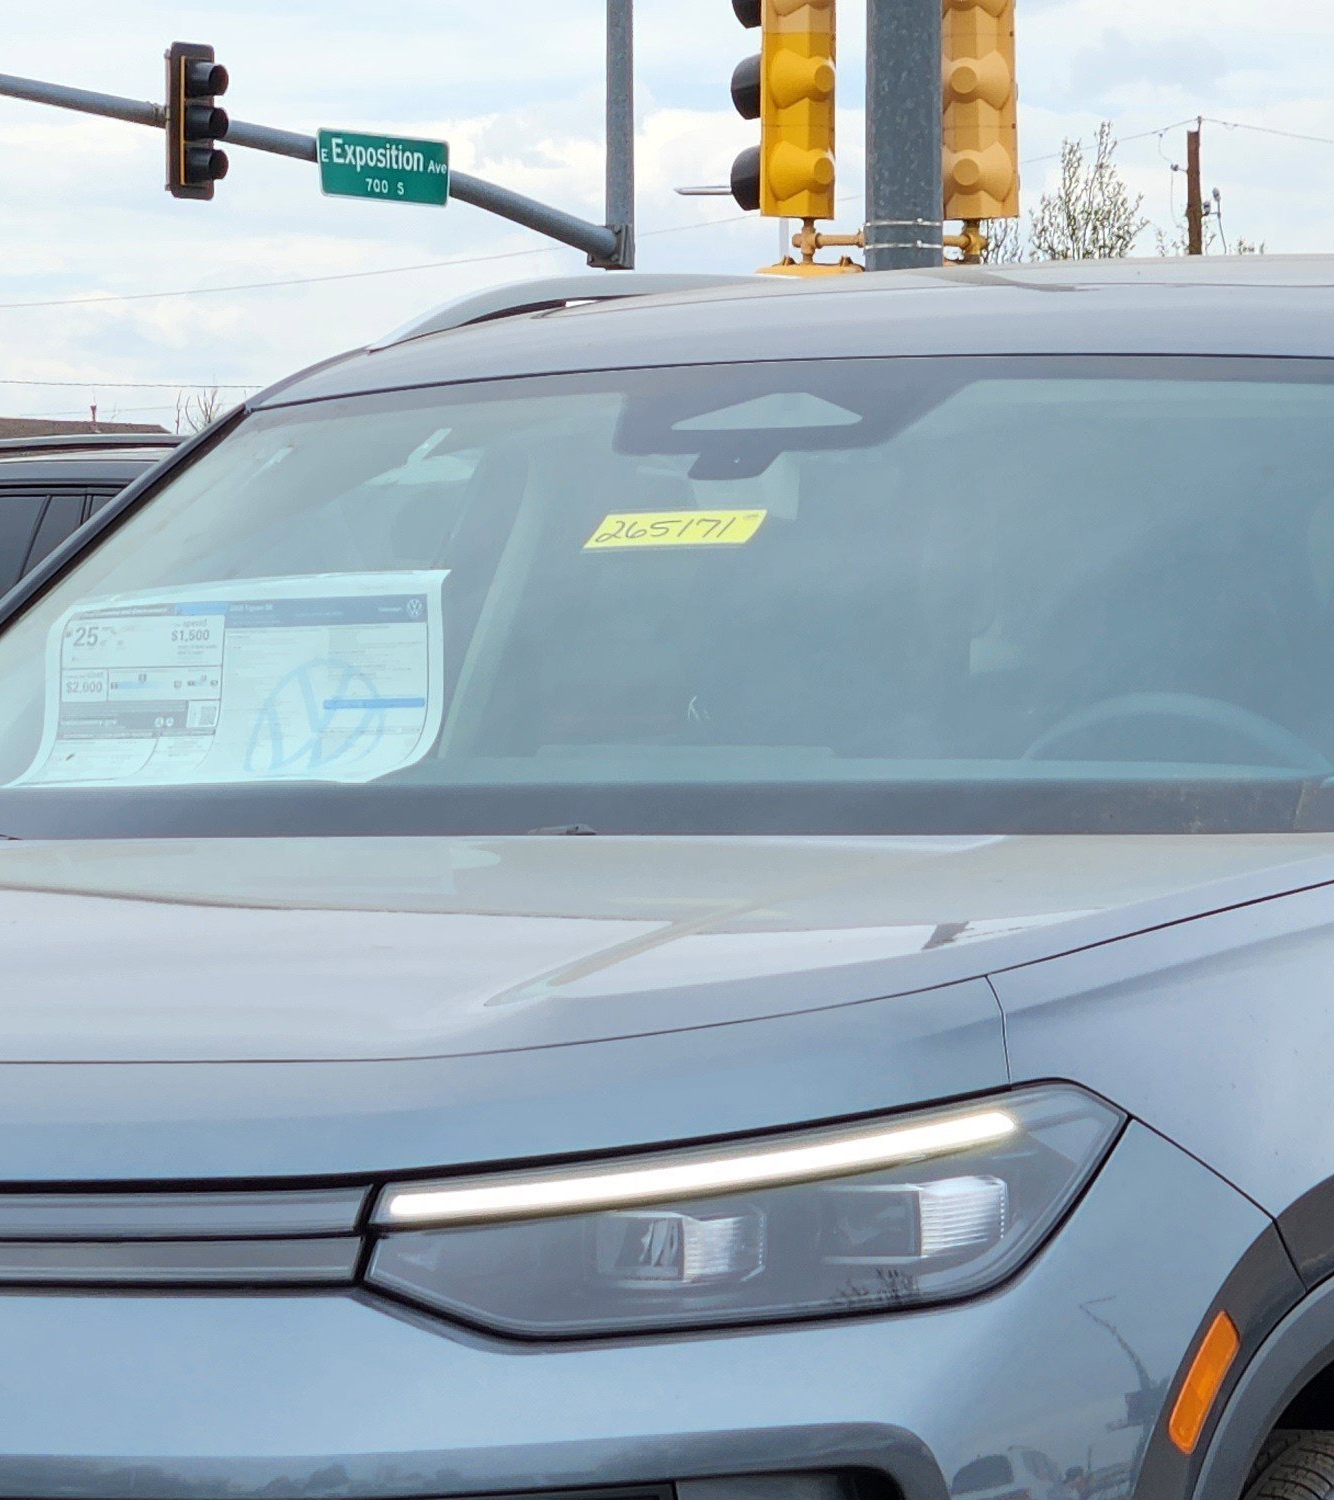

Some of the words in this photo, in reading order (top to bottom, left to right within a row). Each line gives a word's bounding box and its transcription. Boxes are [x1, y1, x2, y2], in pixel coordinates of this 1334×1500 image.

[321, 149, 329, 163] E
[331, 137, 424, 172] Exposition
[427, 160, 447, 174] Ave
[365, 178, 389, 194] 700
[397, 182, 405, 195] S
[73, 627, 100, 647] 25
[171, 629, 210, 643] $1,500
